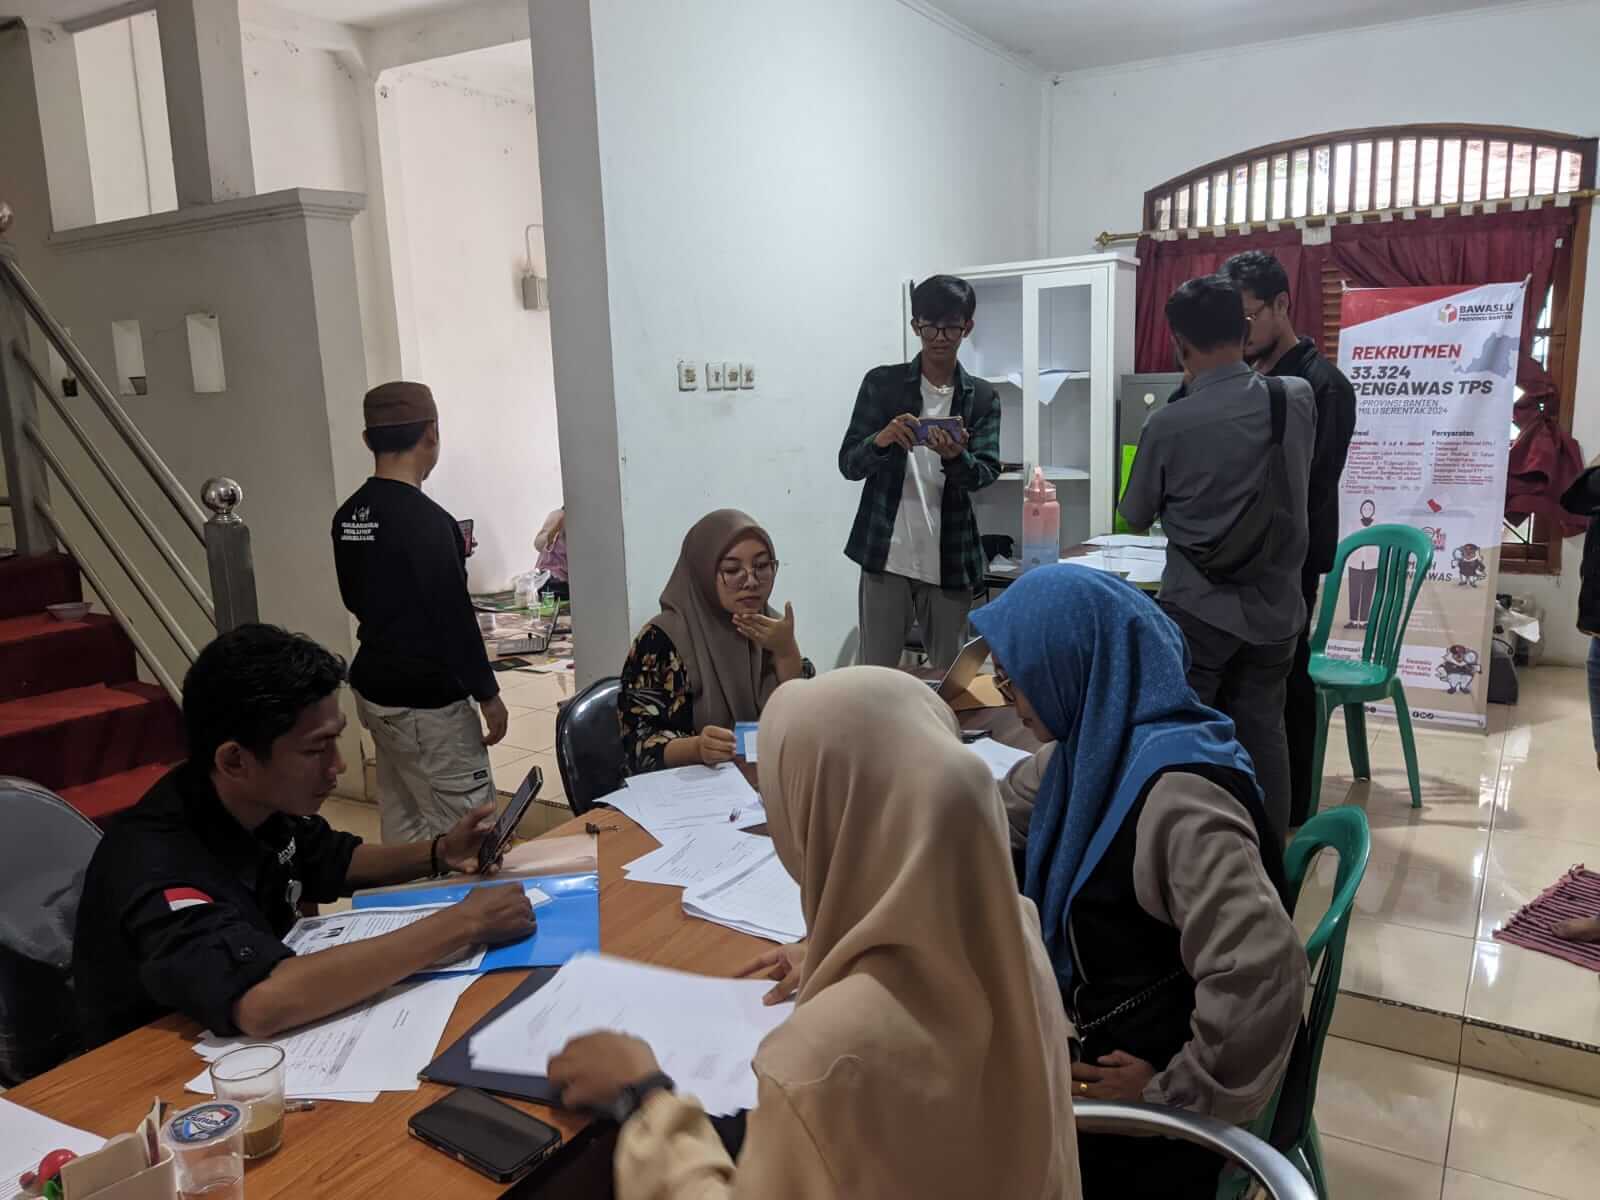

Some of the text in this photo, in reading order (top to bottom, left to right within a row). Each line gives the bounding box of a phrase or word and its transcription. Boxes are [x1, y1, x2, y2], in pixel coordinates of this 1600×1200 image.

[1459, 303, 1514, 313] BAWASLU
[1352, 344, 1462, 360] REKRUTMEN
[1351, 365, 1411, 380] 33.324
[1351, 380, 1493, 395] PENGAWAS TPS
[1402, 399, 1439, 407] BANTEN
